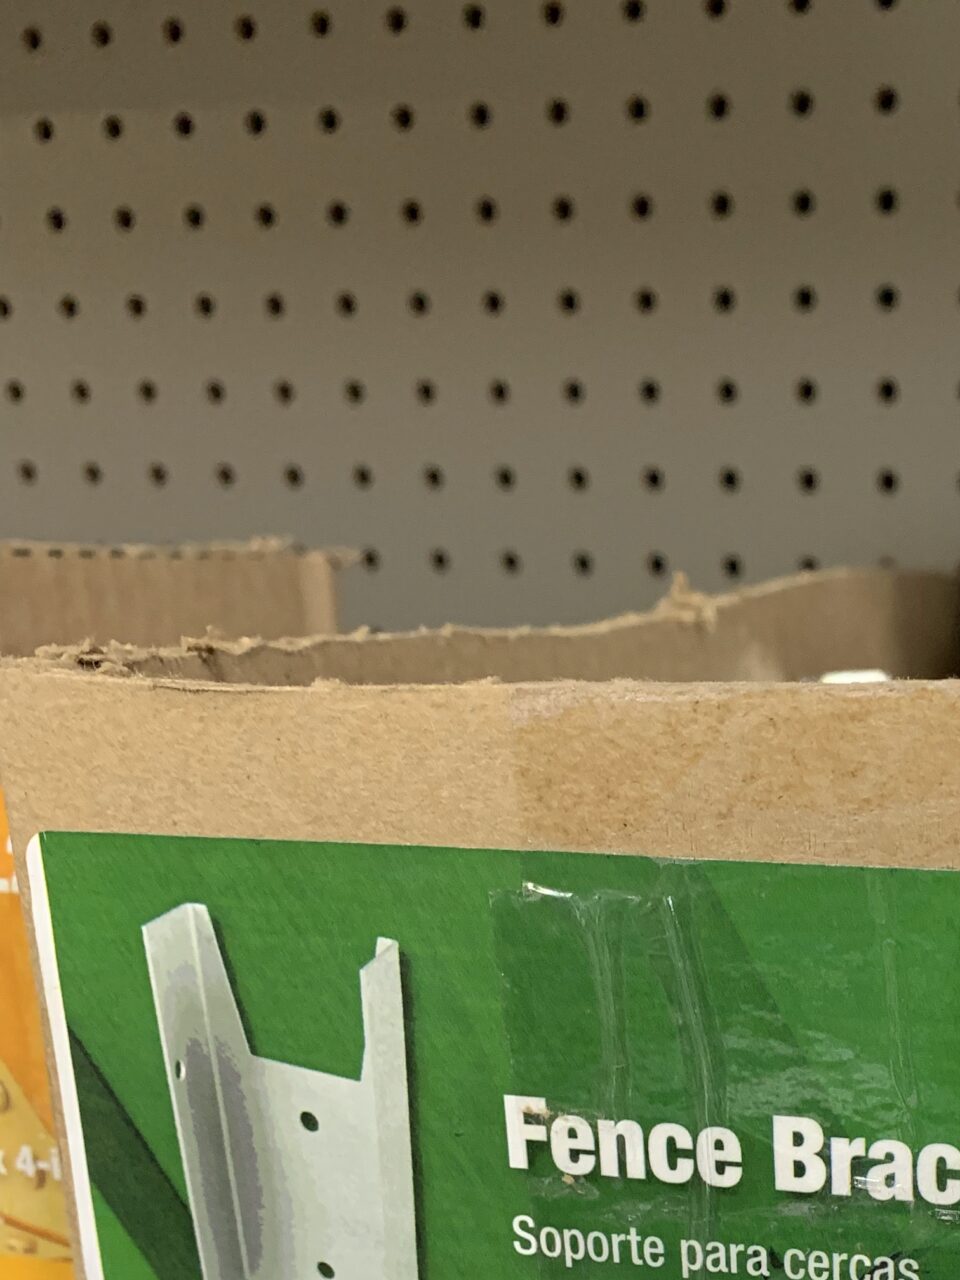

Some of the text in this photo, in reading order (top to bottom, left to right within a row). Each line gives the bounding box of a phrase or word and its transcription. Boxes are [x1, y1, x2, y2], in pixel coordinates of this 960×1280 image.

[503, 1093, 743, 1189] Fence
[513, 1213, 665, 1268] Soporte
[681, 1237, 769, 1279] para
